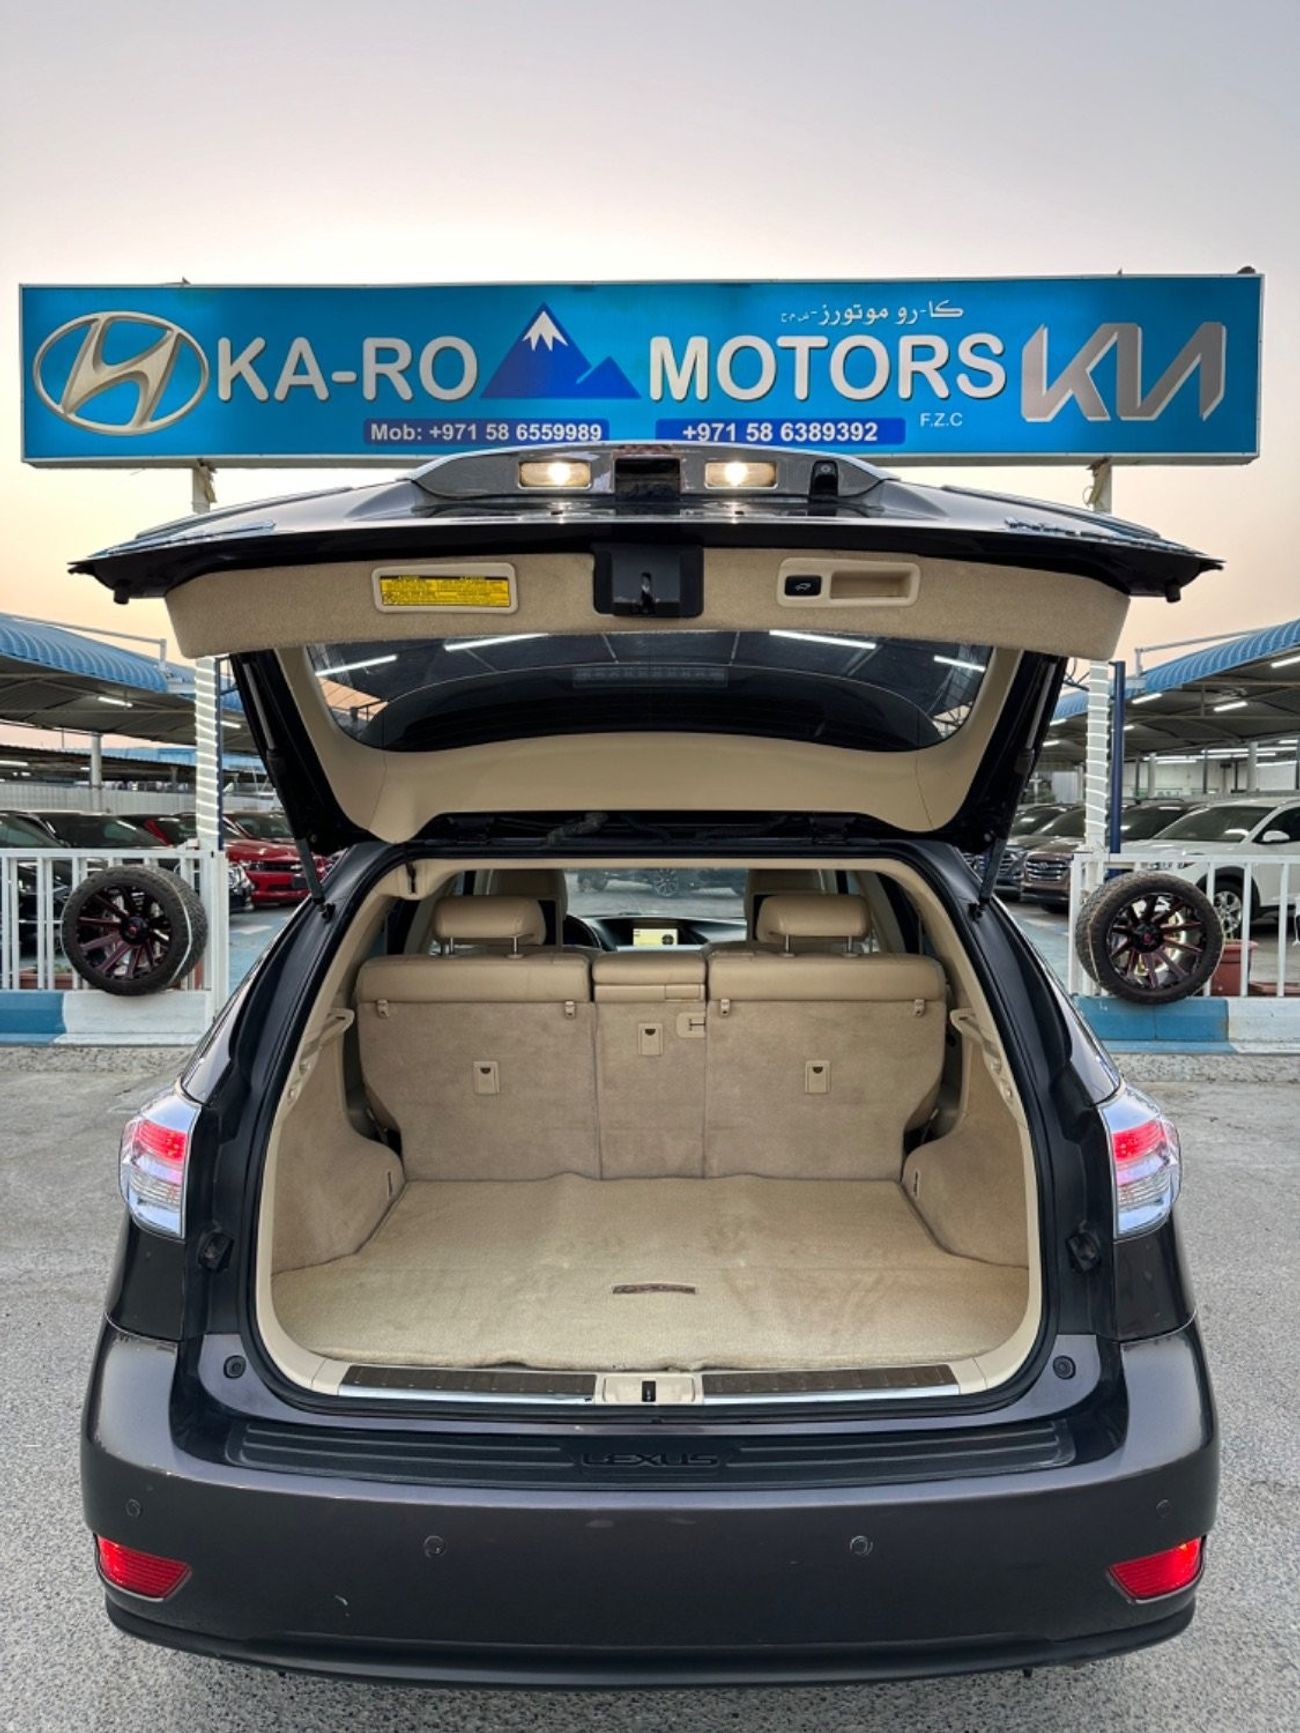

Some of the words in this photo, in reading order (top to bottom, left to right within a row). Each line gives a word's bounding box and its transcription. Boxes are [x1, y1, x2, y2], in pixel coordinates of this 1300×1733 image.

[216, 336, 479, 402] KA-RO
[648, 333, 1008, 402] MOTORS
[370, 423, 422, 441] Mob:
[429, 423, 477, 441] +971
[485, 423, 509, 440] 58
[515, 422, 602, 441] 6559989
[682, 422, 736, 443] +971
[745, 422, 773, 442] 58
[780, 421, 878, 442] 6389392
[582, 1452, 720, 1467] LEXUS
